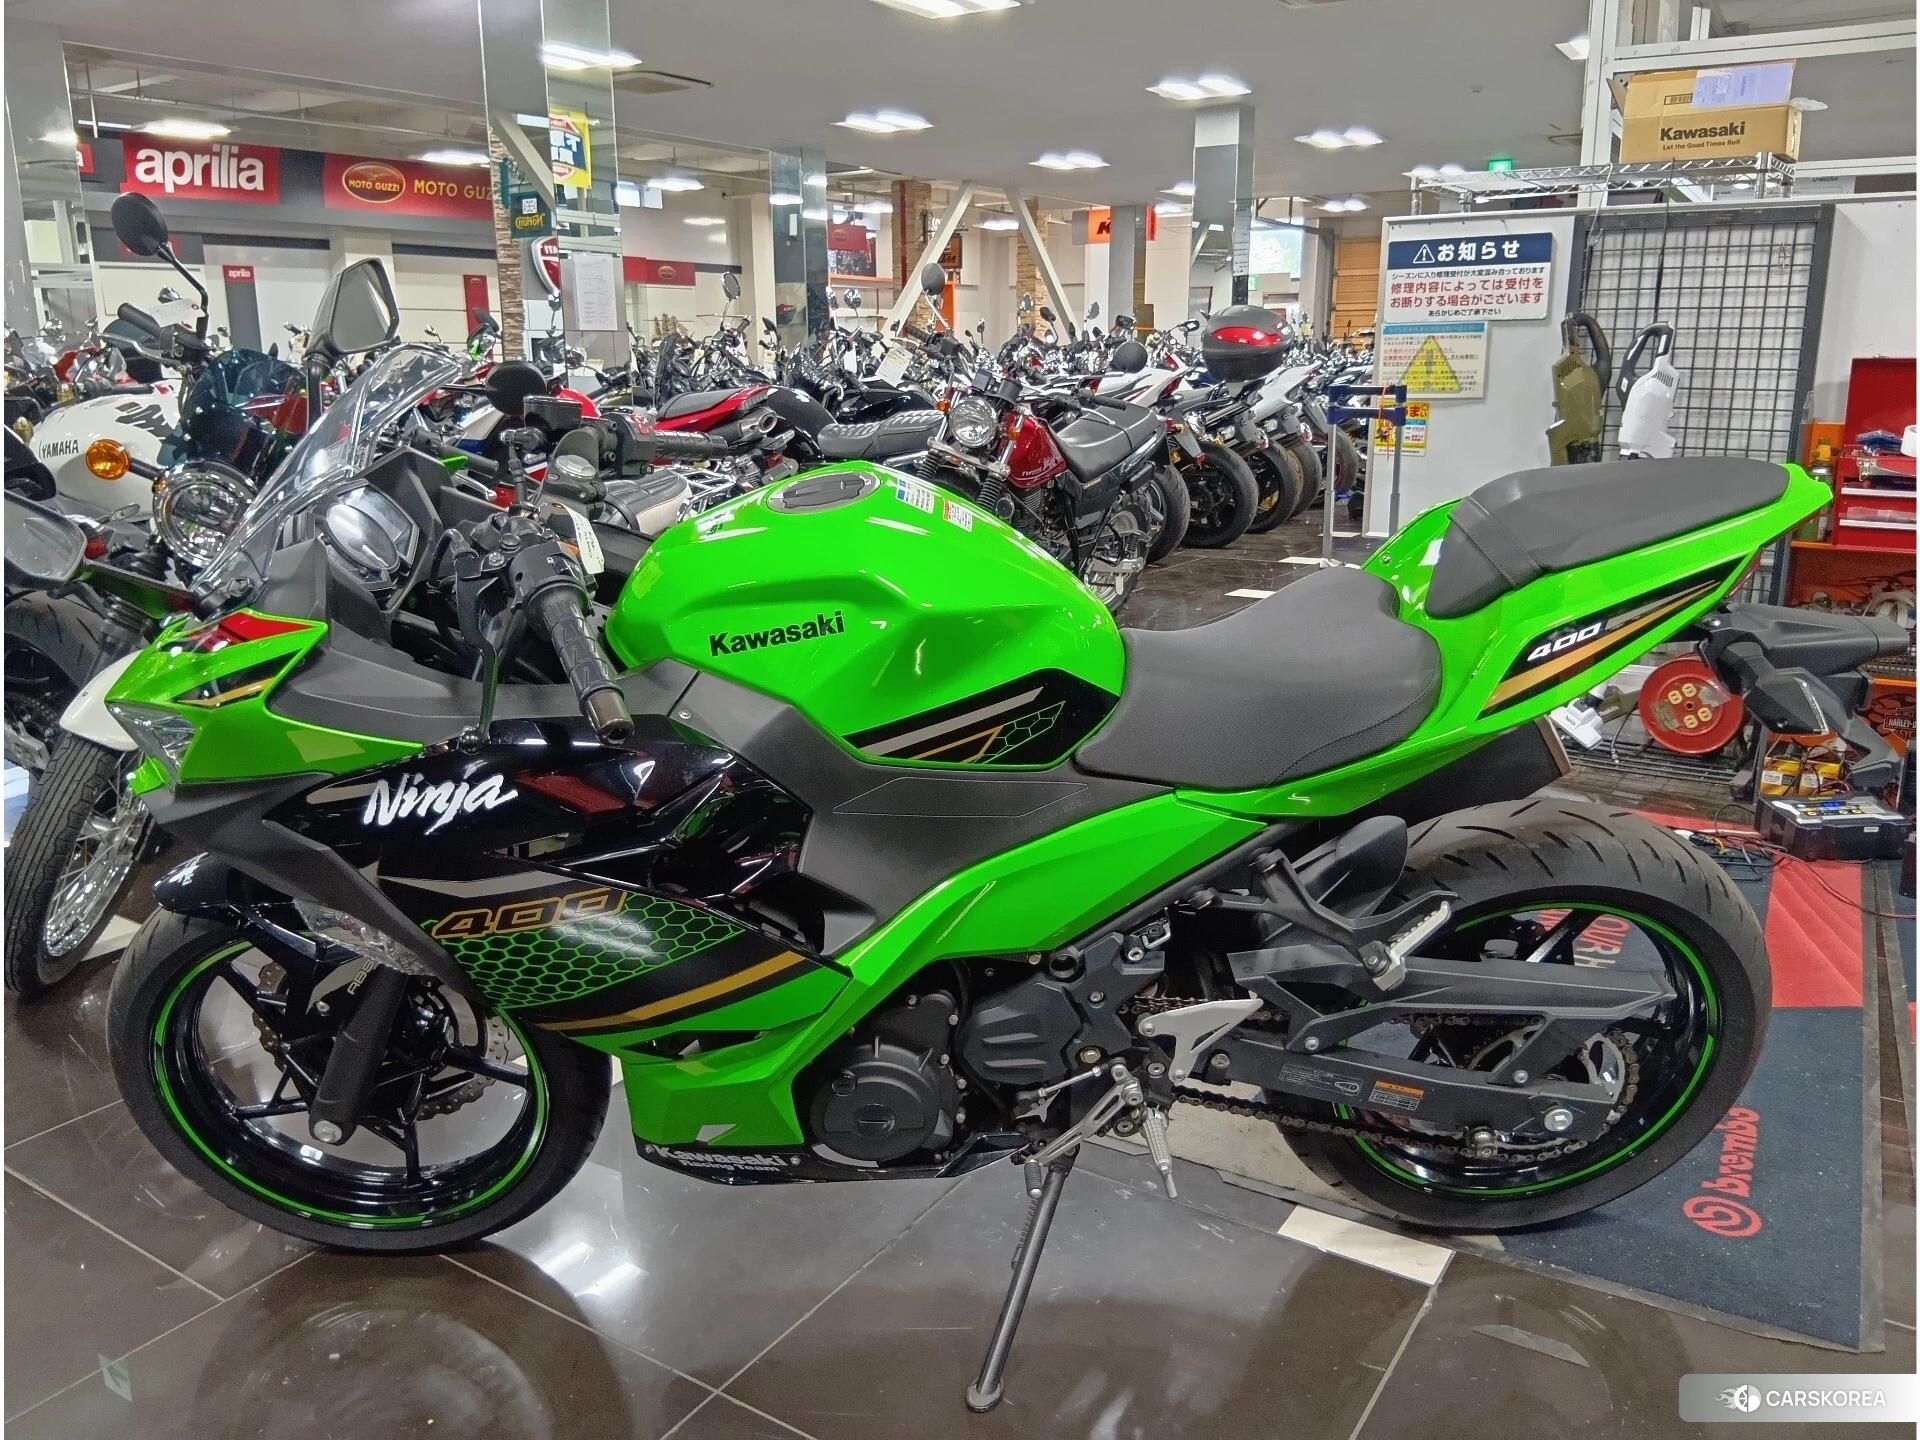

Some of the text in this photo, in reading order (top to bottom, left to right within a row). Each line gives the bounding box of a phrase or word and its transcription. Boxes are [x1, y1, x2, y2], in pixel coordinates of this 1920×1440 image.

[1660, 121, 1746, 141] Kawasaki
[1686, 141, 1705, 149] Good
[1727, 138, 1741, 146] Roll
[135, 144, 264, 193] aprilia
[348, 180, 400, 192] MOTO GUZZI
[414, 179, 458, 197] MOTO
[1437, 240, 1520, 262] お知らせ
[1390, 277, 1544, 294] 修理内容によっては受付を
[1390, 292, 1544, 309] お断りする場合がございます
[1428, 308, 1501, 317] あらかじめご了承下さい
[41, 439, 79, 460] YAMAHA
[709, 611, 845, 657] Kawasaki
[1527, 622, 1601, 662] 400
[363, 773, 518, 835] Ninja
[432, 886, 628, 939] 400
[347, 960, 375, 995] ABS
[652, 1145, 788, 1166] Kawasaki
[1702, 1107, 1760, 1198] brembo
[679, 1159, 781, 1172] Racing Team
